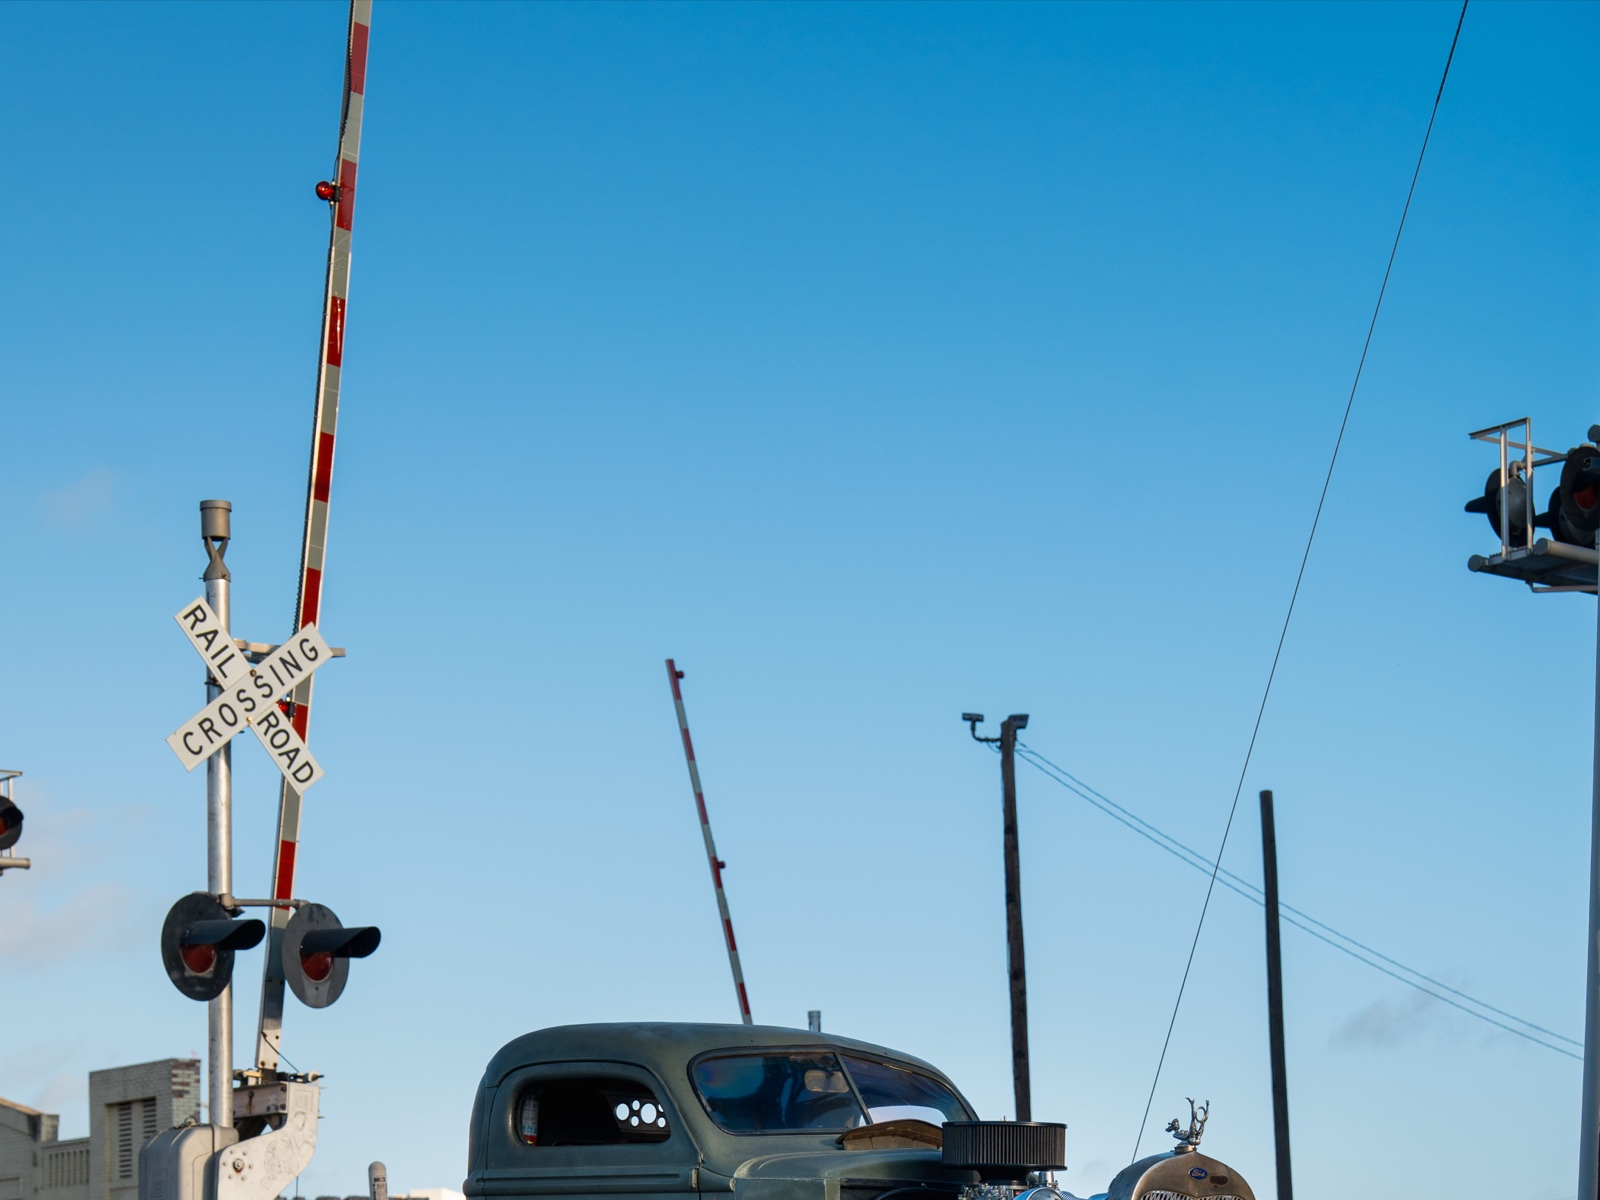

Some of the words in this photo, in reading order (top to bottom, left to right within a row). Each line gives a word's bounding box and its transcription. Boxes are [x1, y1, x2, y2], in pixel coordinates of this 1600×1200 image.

[183, 604, 235, 679] RAIL
[182, 638, 319, 756] CROSSING
[256, 711, 314, 784] ROAD
